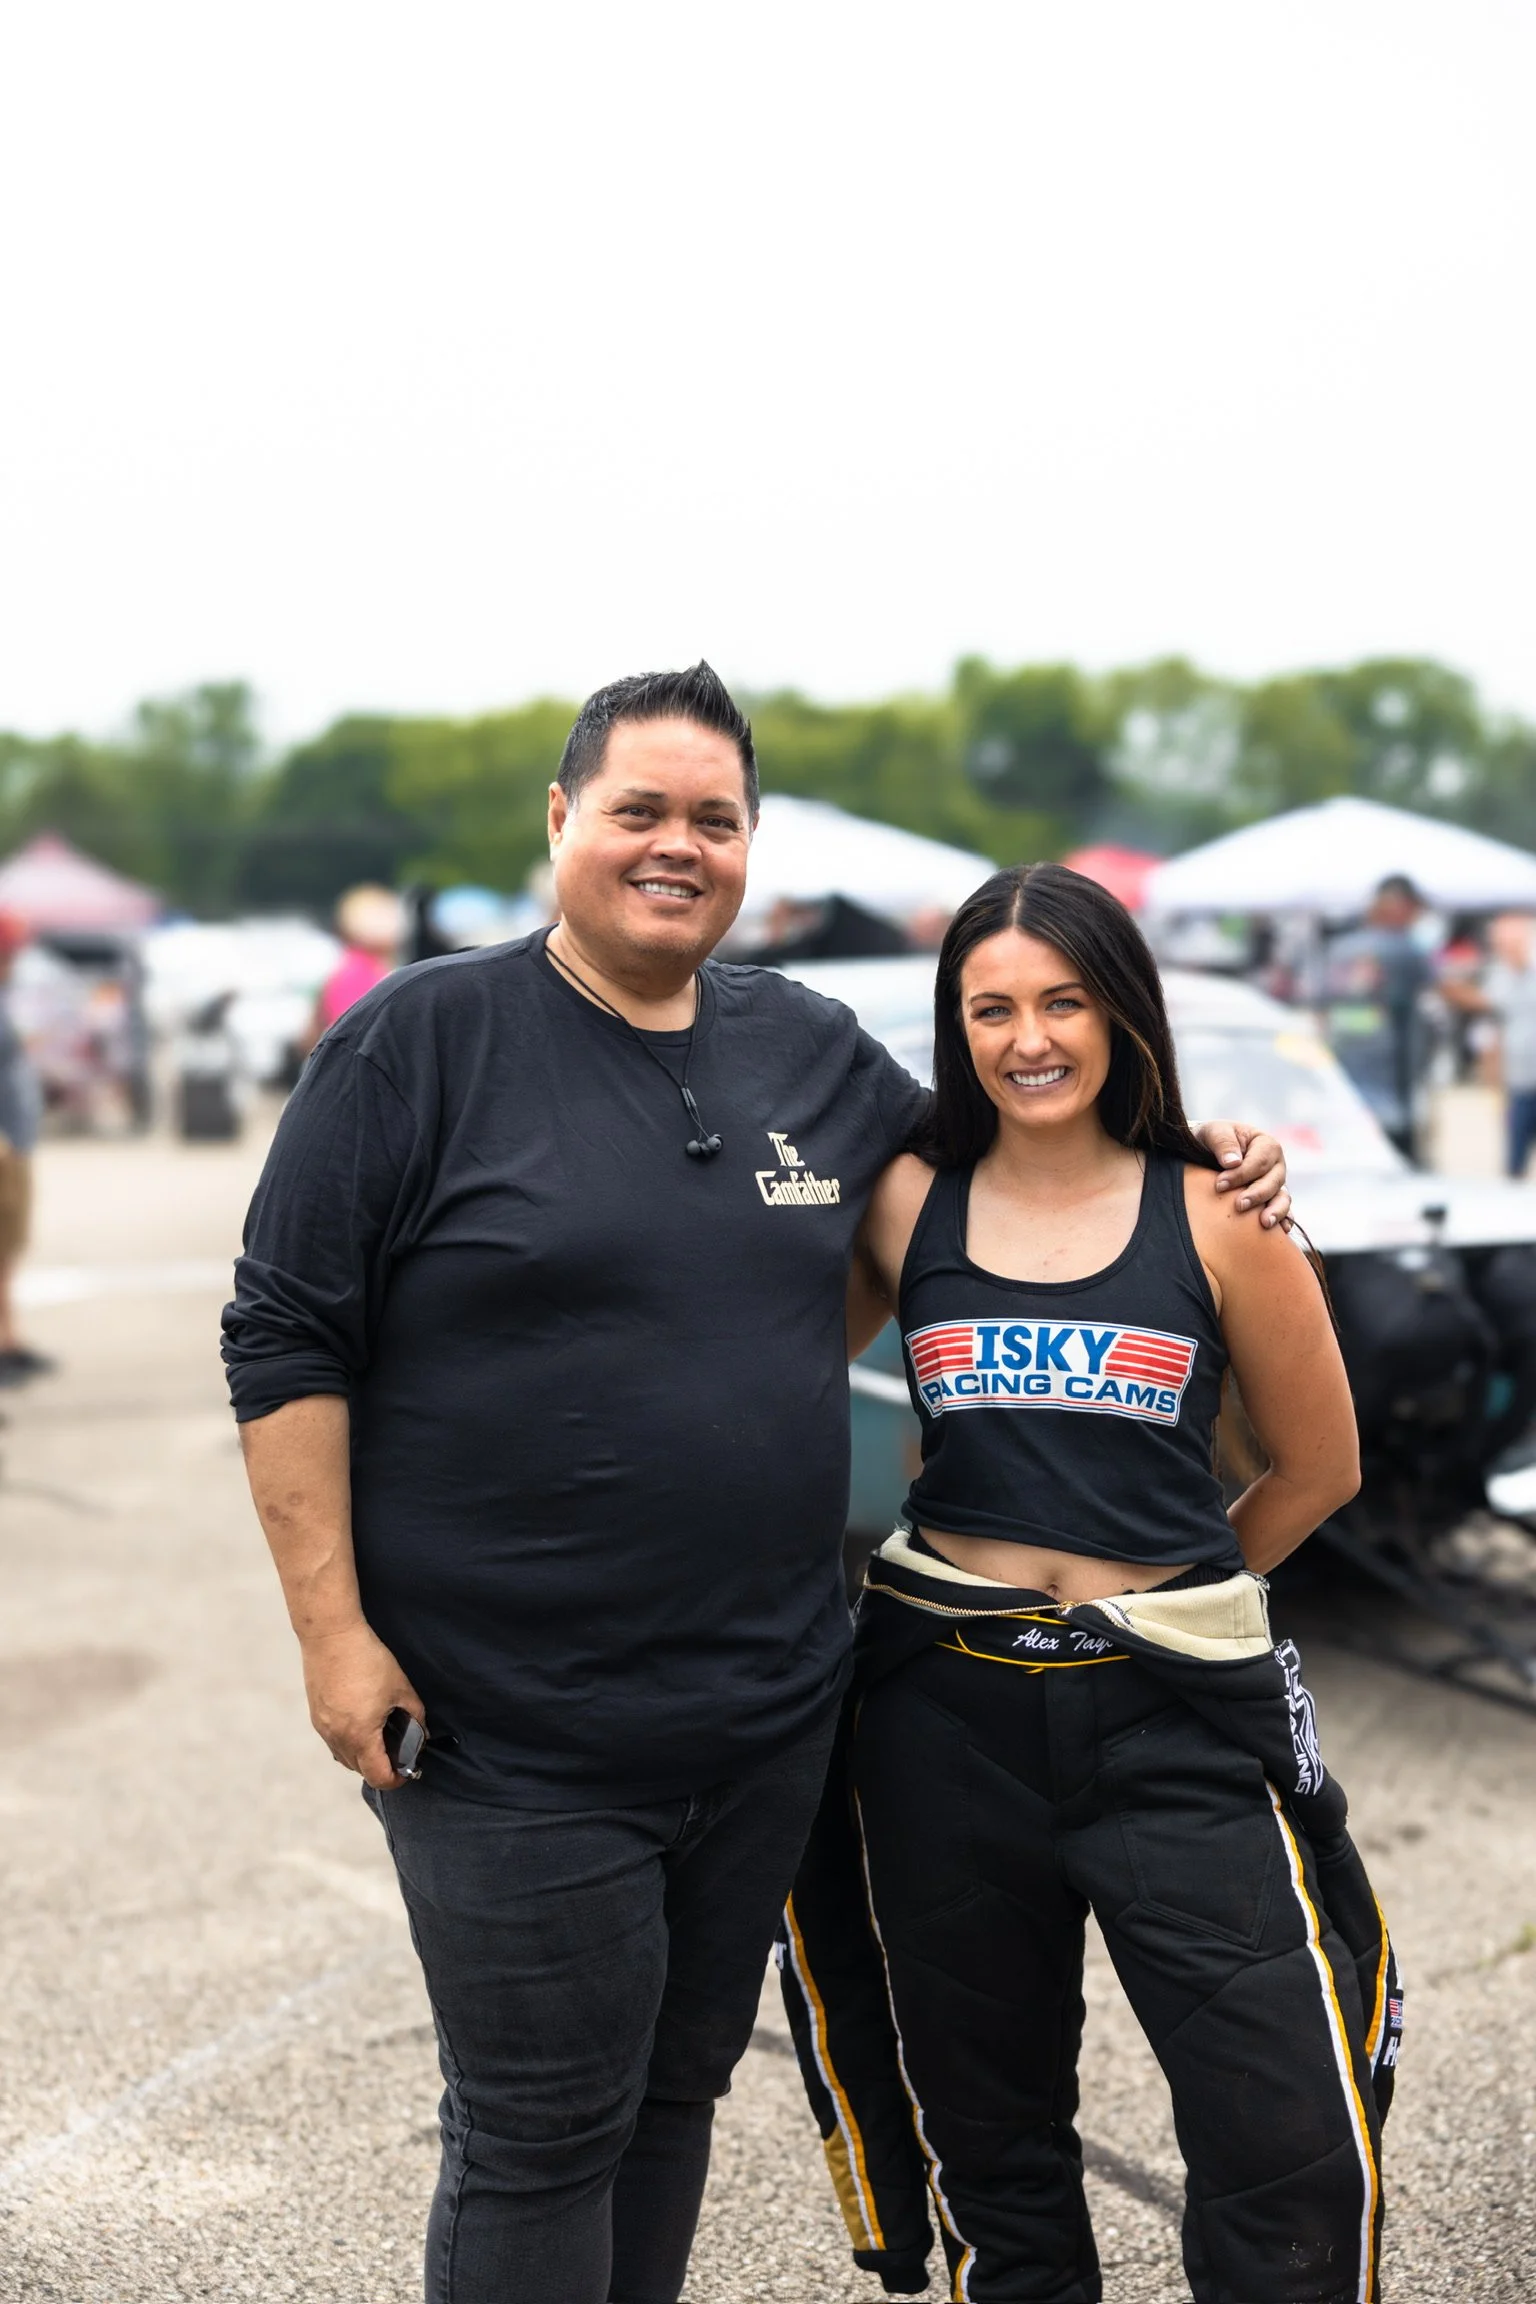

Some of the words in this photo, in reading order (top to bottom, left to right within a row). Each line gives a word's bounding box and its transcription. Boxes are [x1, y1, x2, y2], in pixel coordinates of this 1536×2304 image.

[767, 1132, 805, 1167] The
[755, 1170, 841, 1206] Camfather
[976, 1325, 1118, 1375] ISKY
[921, 1373, 1052, 1406] RACING
[1065, 1376, 1177, 1414] CAMS
[1012, 1627, 1060, 1650] Alex
